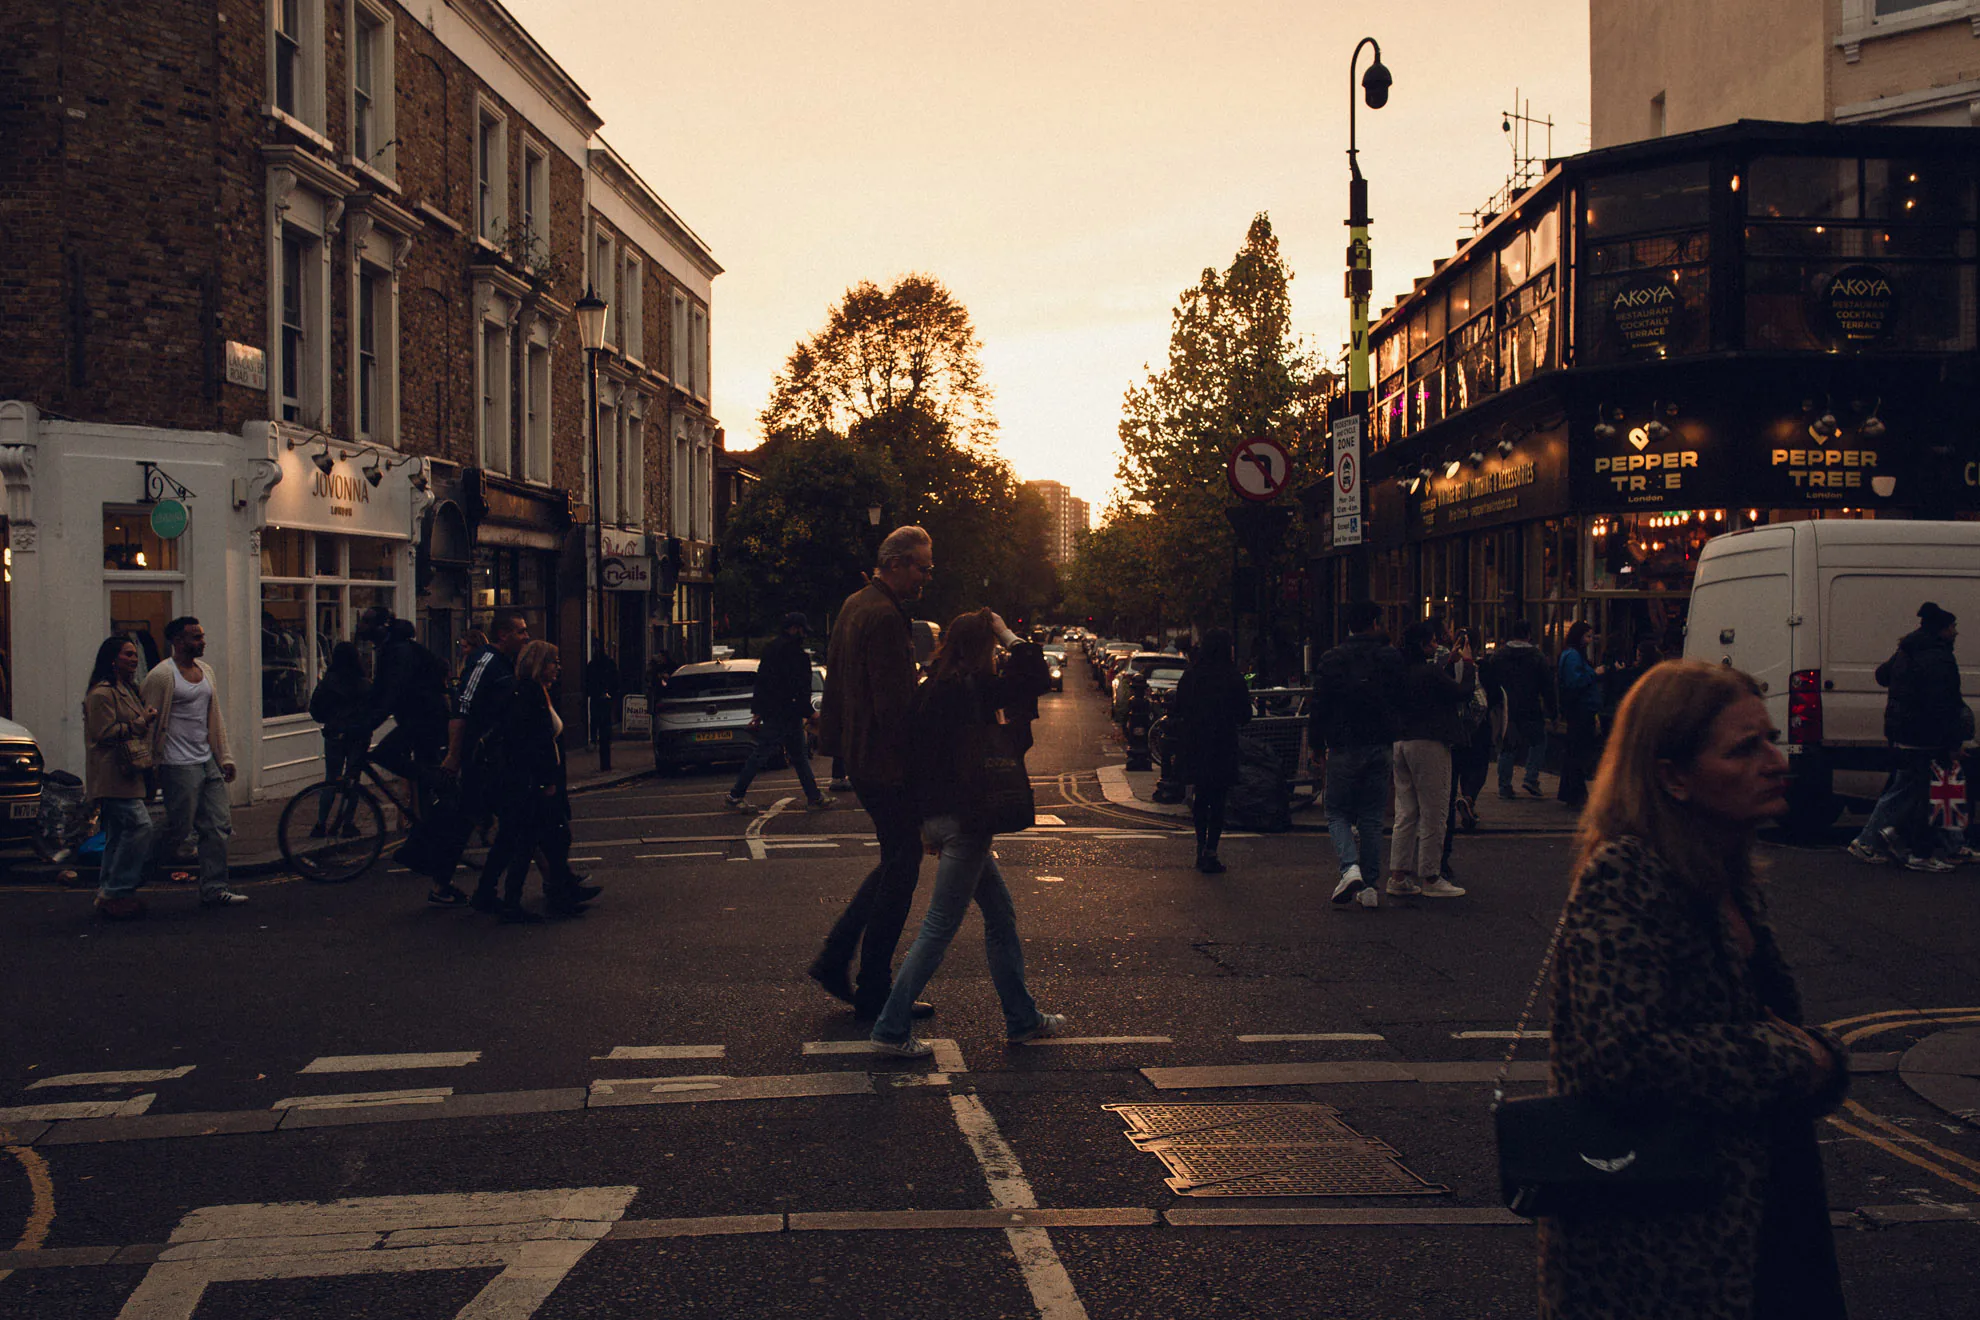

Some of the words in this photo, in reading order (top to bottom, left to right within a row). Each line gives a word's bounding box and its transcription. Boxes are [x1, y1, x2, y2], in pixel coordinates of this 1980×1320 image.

[1831, 279, 1892, 296] AKOYA
[1613, 285, 1675, 310] AKOYA
[1832, 300, 1889, 308] RESTAURANT
[1616, 306, 1673, 321] RESTAURANT
[1836, 310, 1884, 319] COCKTAILS
[1620, 316, 1669, 331] COCKTAILS
[1841, 320, 1882, 329] TERRACE
[1625, 326, 1665, 340] TERRACE
[230, 367, 249, 382] ROAD
[1338, 436, 1355, 450] ZONE
[1595, 451, 1698, 473] PEPPER
[1772, 449, 1878, 467] PEPPER
[1499, 461, 1534, 491] ACCESSORIES
[1788, 470, 1861, 487] TREE
[1964, 461, 1980, 487] C
[312, 471, 369, 503] JOVONNA
[1611, 473, 1682, 492] TRE
[1628, 494, 1664, 503] London
[1806, 491, 1843, 499] London
[331, 505, 353, 517] LONDON
[607, 563, 647, 582] nails
